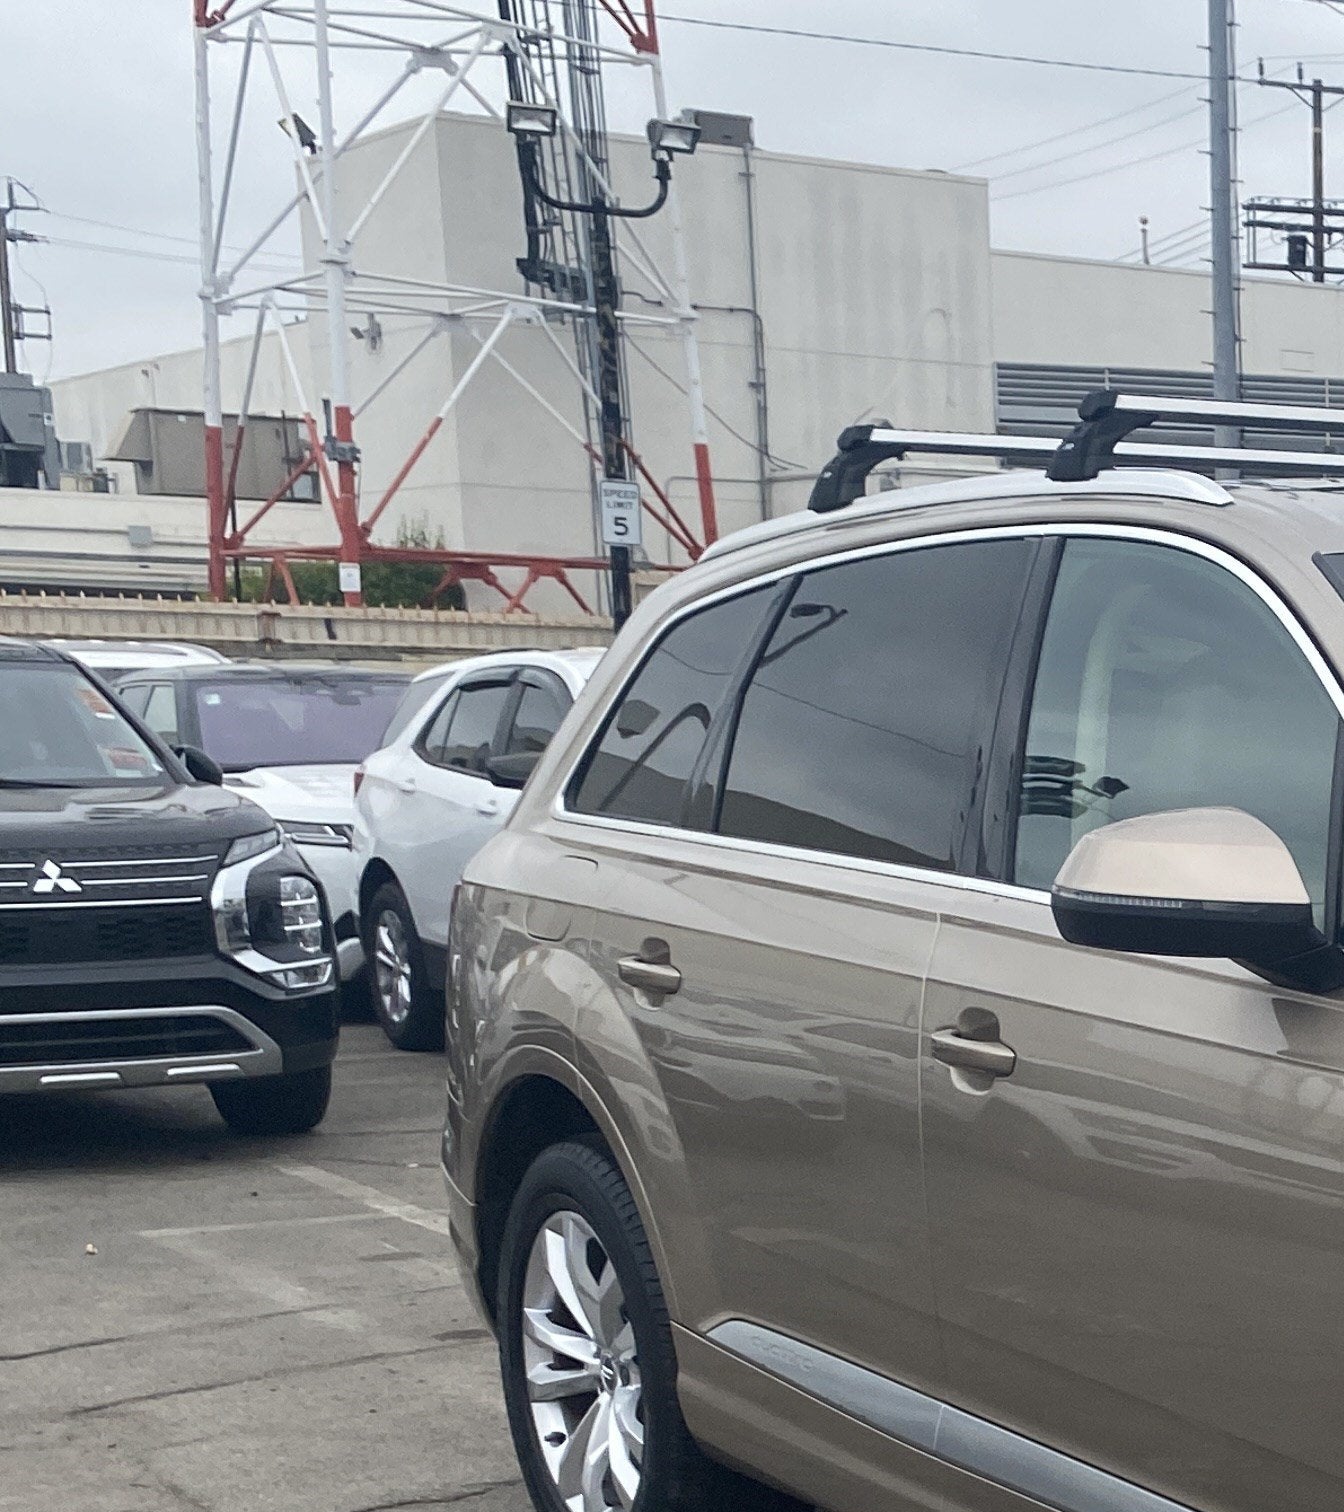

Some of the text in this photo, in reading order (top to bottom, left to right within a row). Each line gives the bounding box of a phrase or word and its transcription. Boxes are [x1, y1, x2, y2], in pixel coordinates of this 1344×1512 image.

[603, 489, 637, 499] SPEED
[606, 501, 633, 510] LIMIT
[614, 516, 629, 536] 5
